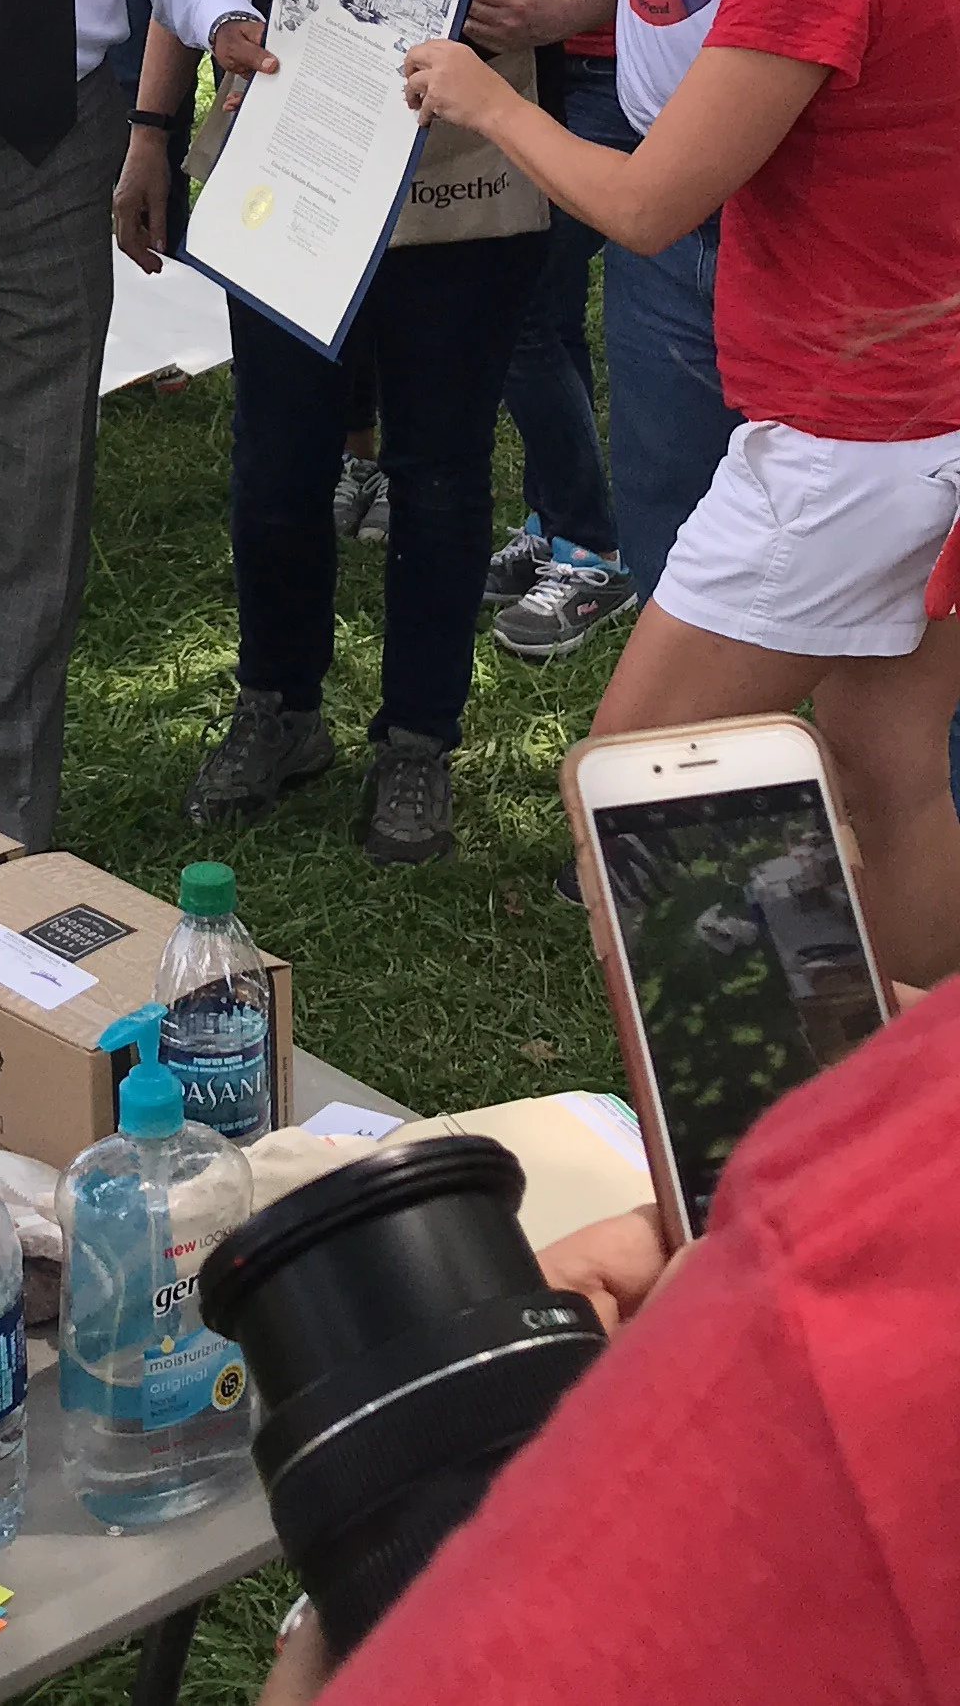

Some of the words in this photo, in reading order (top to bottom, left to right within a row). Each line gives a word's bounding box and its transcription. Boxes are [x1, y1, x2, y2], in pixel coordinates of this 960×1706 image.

[182, 1071, 261, 1110] ASANI
[164, 1240, 197, 1260] new
[155, 1272, 202, 1315] ger
[150, 1367, 208, 1394] original
